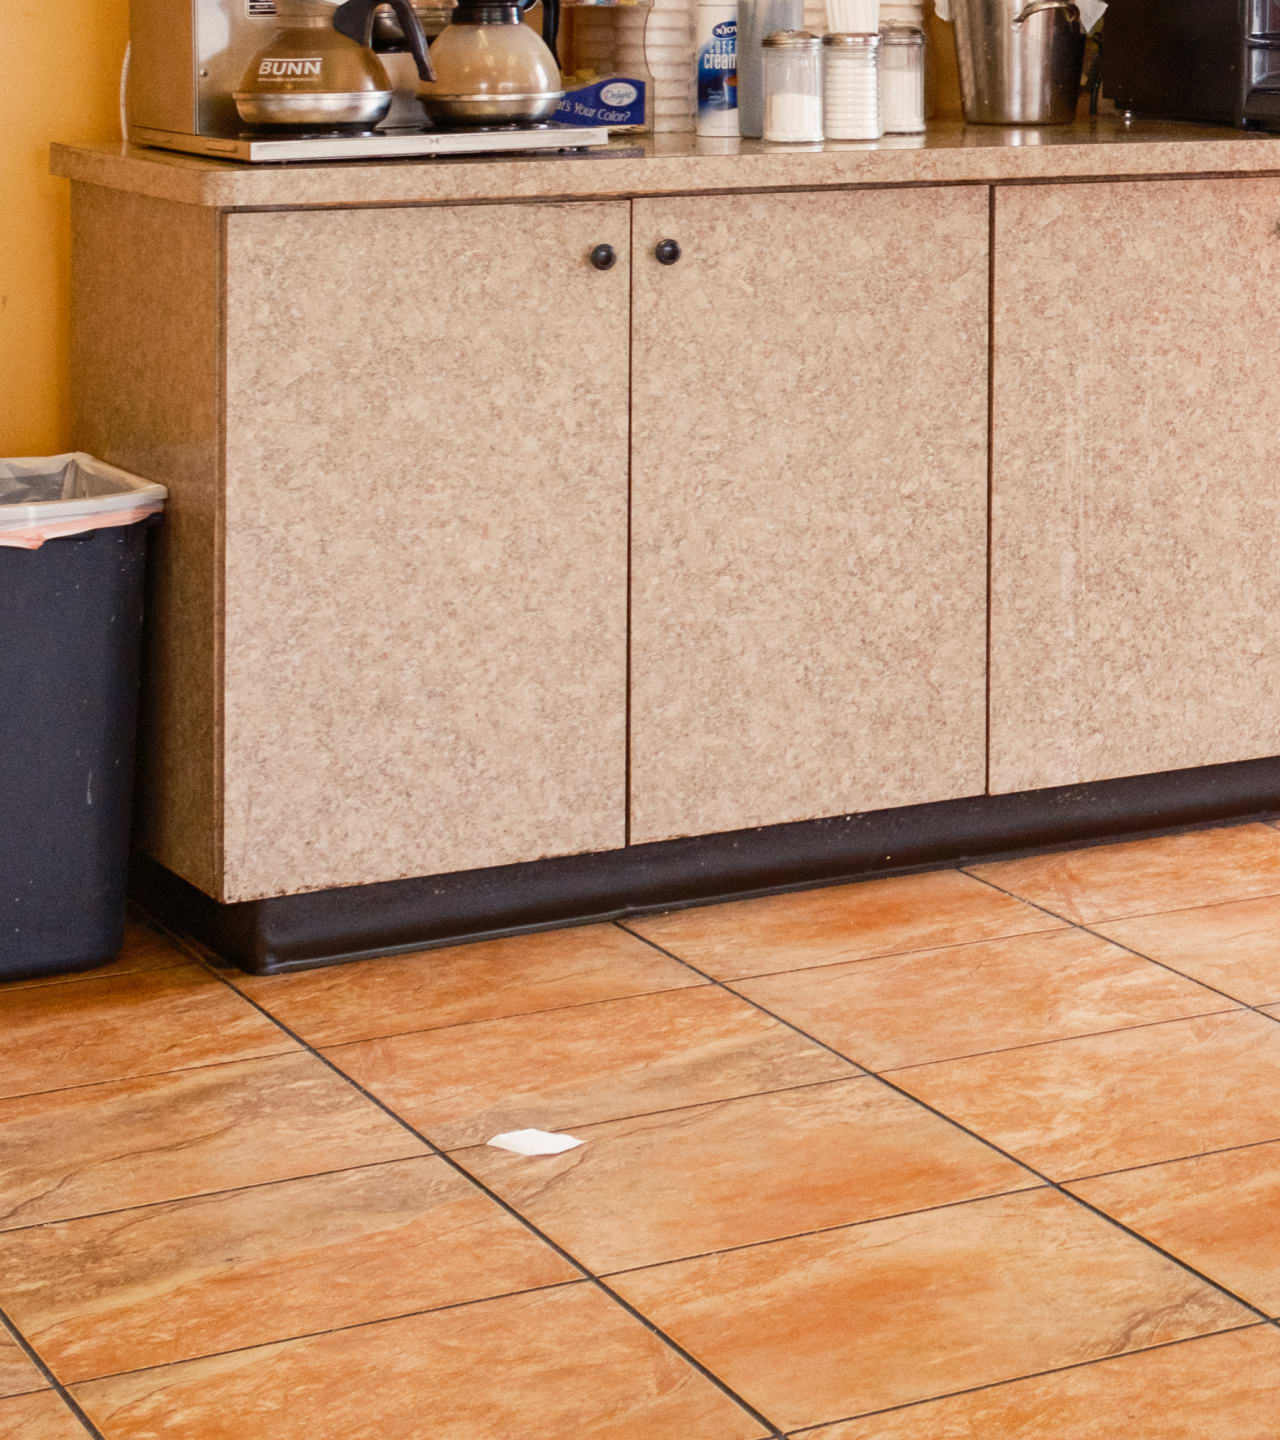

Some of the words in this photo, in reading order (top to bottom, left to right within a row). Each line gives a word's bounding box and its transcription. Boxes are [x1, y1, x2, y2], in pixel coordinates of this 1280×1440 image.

[258, 61, 322, 75] BUNN
[574, 103, 595, 117] Your
[598, 110, 630, 122] Color?
